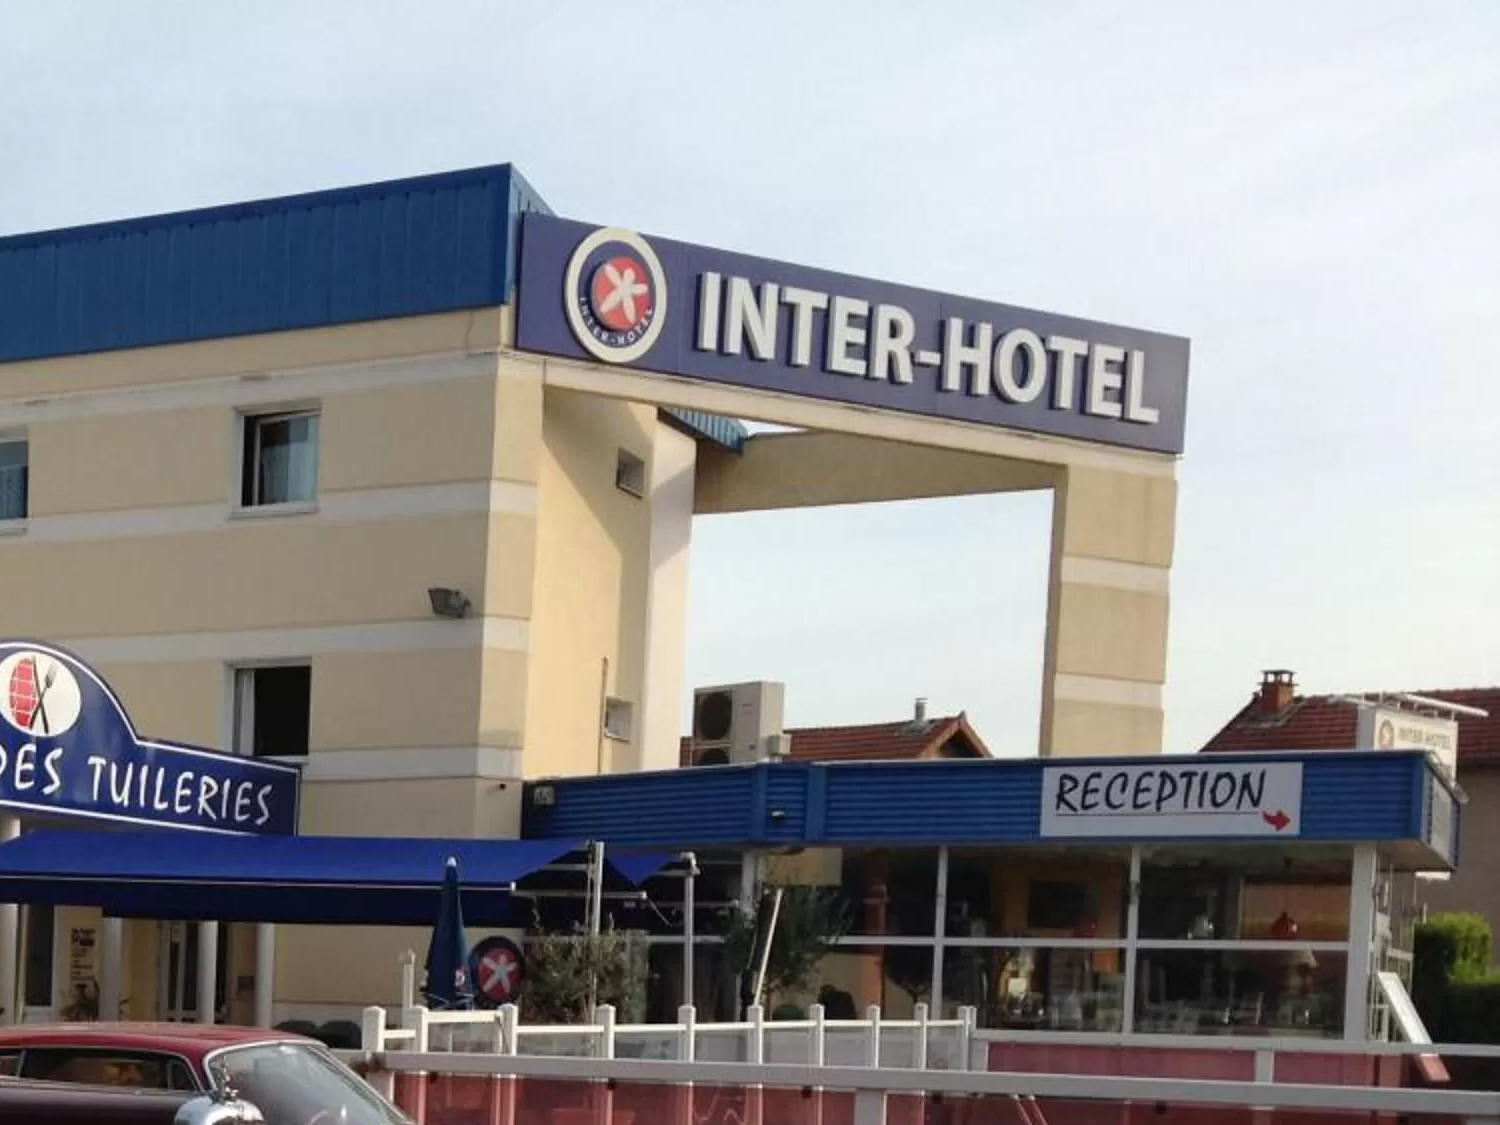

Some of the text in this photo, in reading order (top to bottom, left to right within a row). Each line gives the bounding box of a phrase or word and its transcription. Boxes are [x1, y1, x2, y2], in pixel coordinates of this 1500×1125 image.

[697, 271, 1161, 425] INTER-HOTEL
[87, 756, 274, 826] TUILERIES
[1055, 769, 1267, 813] RECEPTION
